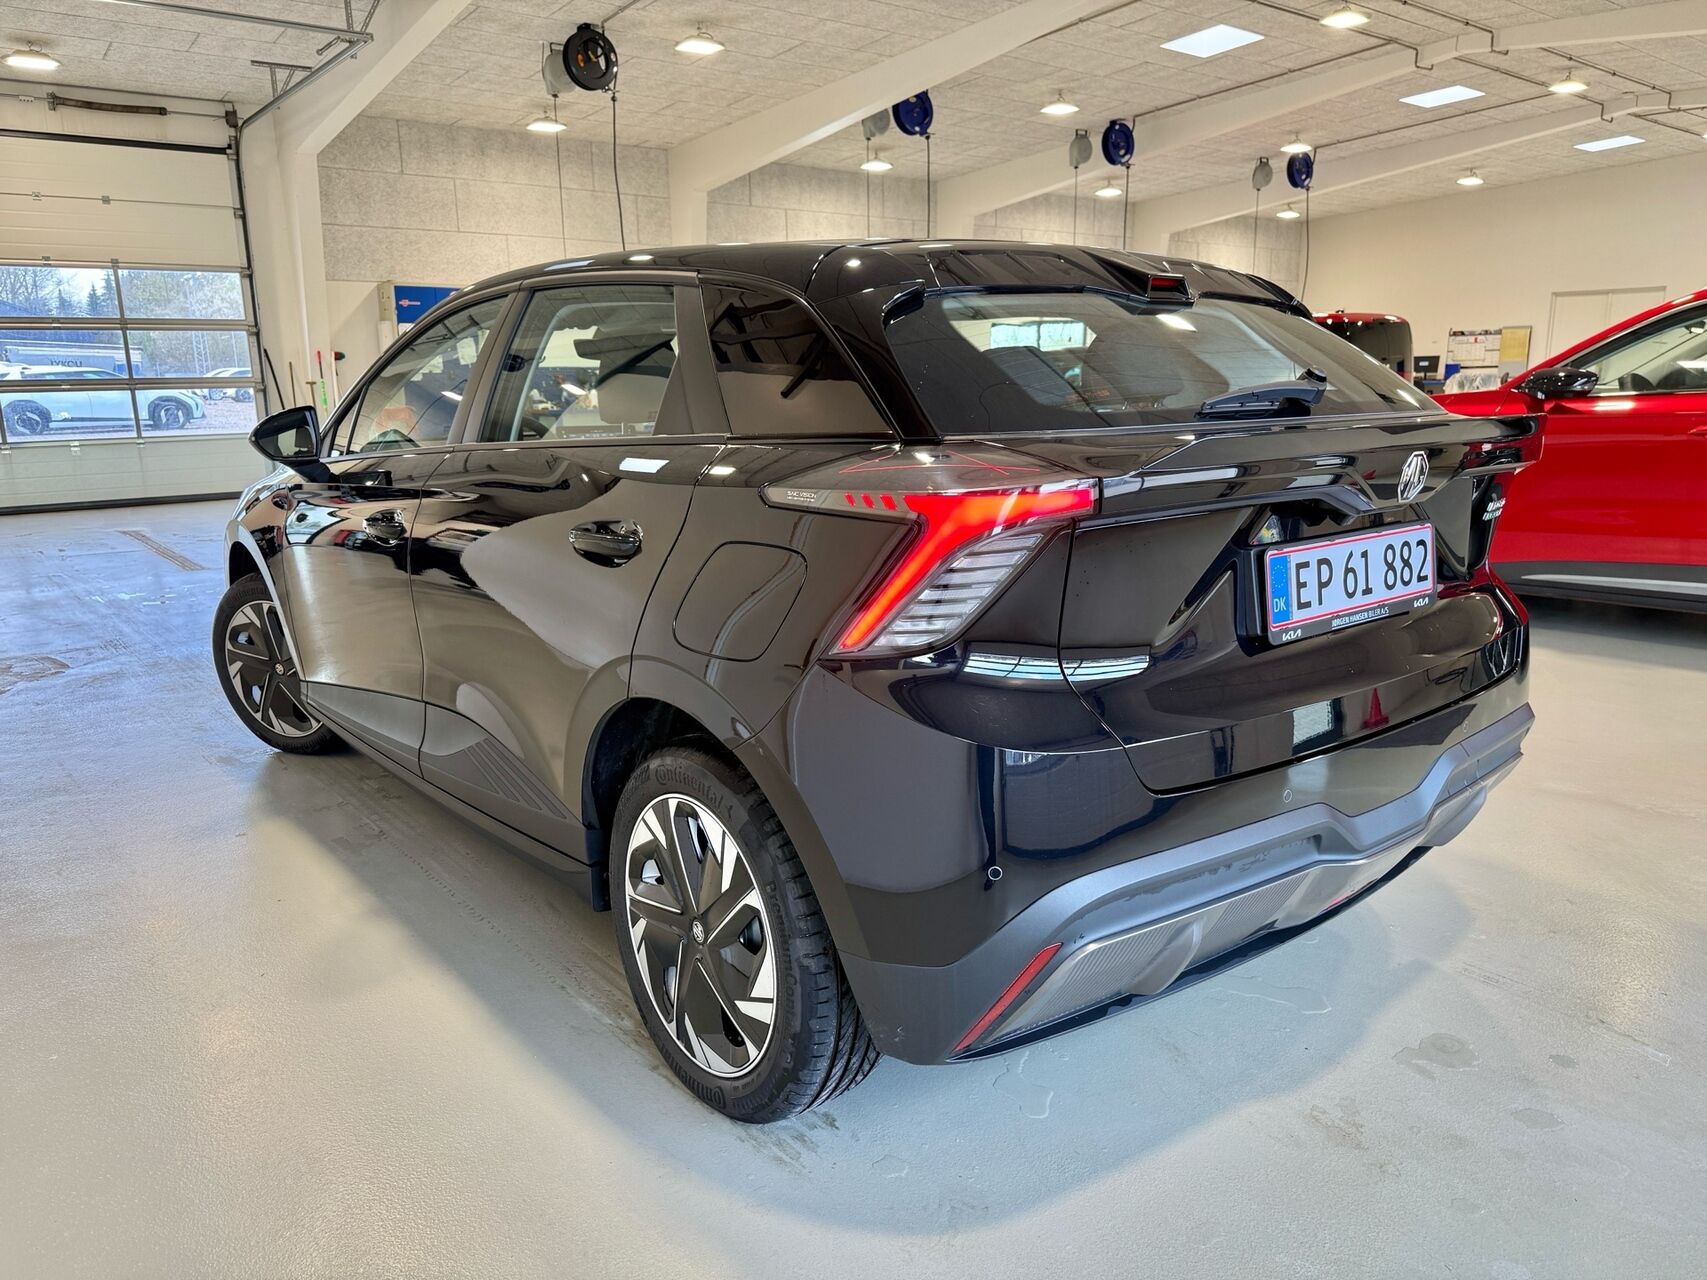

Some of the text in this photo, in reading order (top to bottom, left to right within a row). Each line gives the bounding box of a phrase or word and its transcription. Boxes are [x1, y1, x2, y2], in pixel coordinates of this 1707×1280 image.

[1294, 538, 1429, 610] EP 61 882
[1273, 598, 1287, 612] DK
[1349, 611, 1369, 623] HANSEN
[1381, 606, 1389, 615] A/S
[655, 764, 724, 810] Continental
